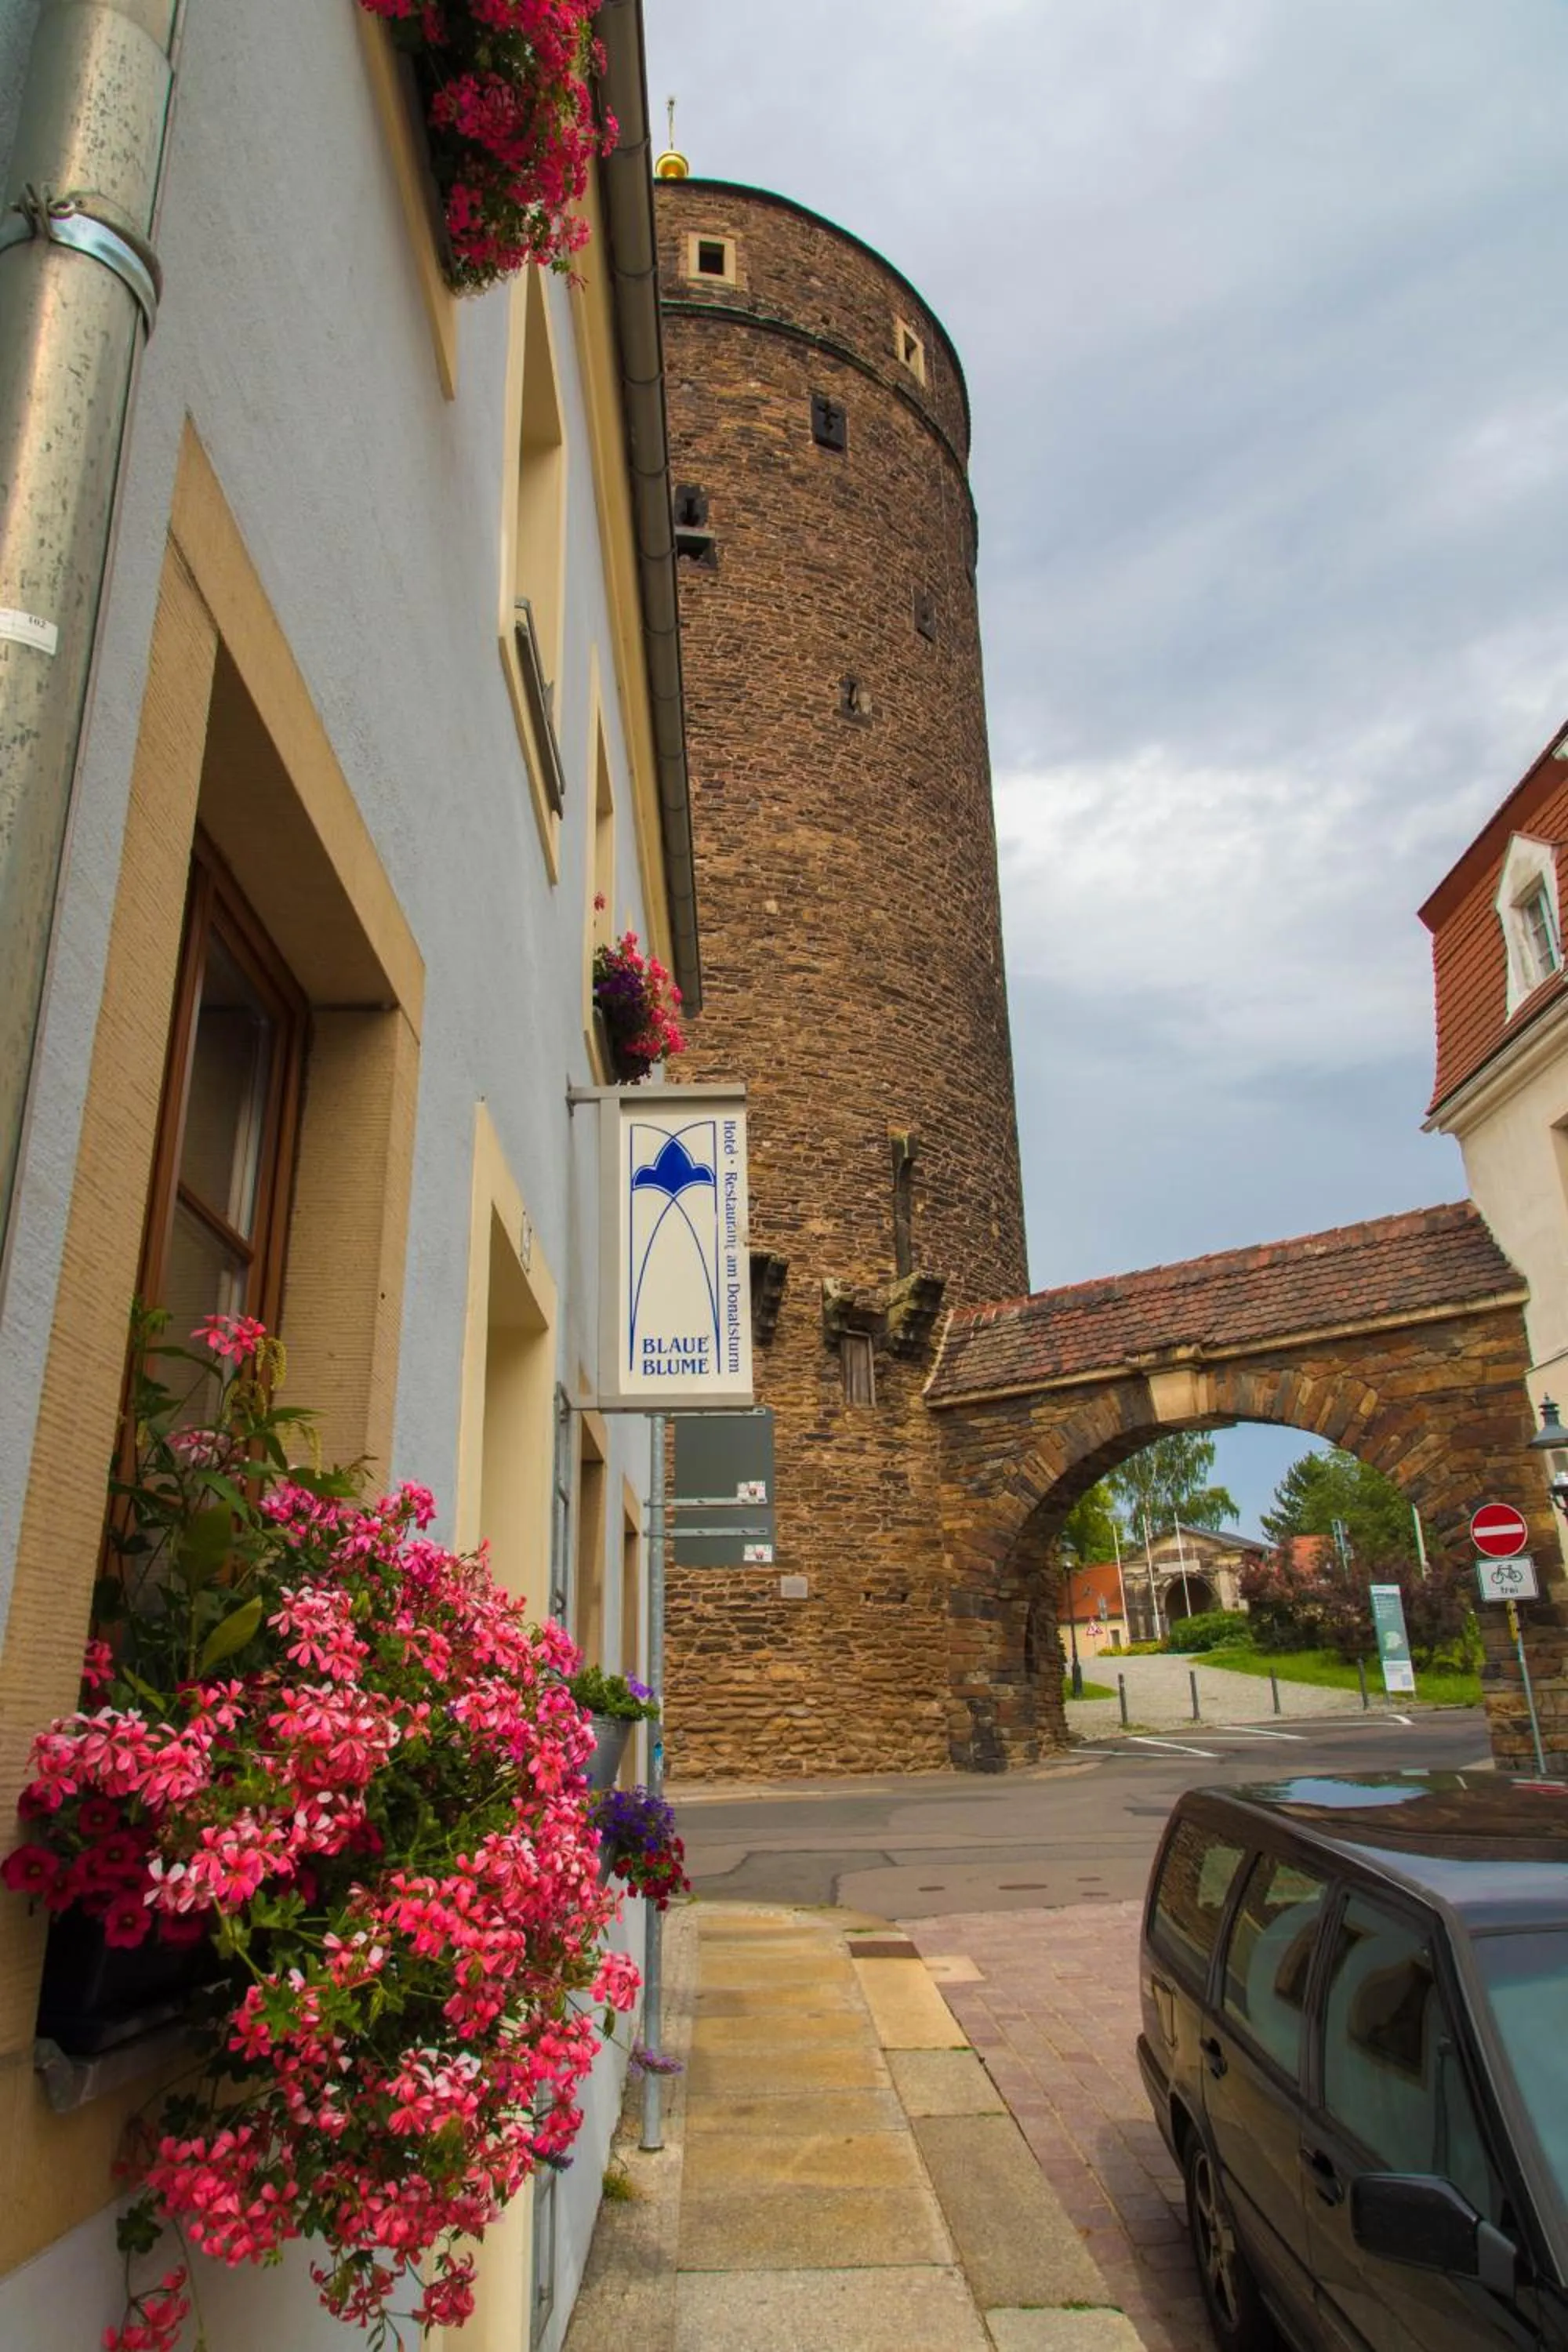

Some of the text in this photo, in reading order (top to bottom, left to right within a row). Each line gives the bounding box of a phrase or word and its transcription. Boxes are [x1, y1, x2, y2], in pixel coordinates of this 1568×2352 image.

[723, 1120, 737, 1155] Hotel
[726, 1256, 738, 1277] am
[727, 1283, 741, 1374] Donatsturm
[642, 1336, 709, 1354] BLAUE
[642, 1359, 709, 1375] BLUME
